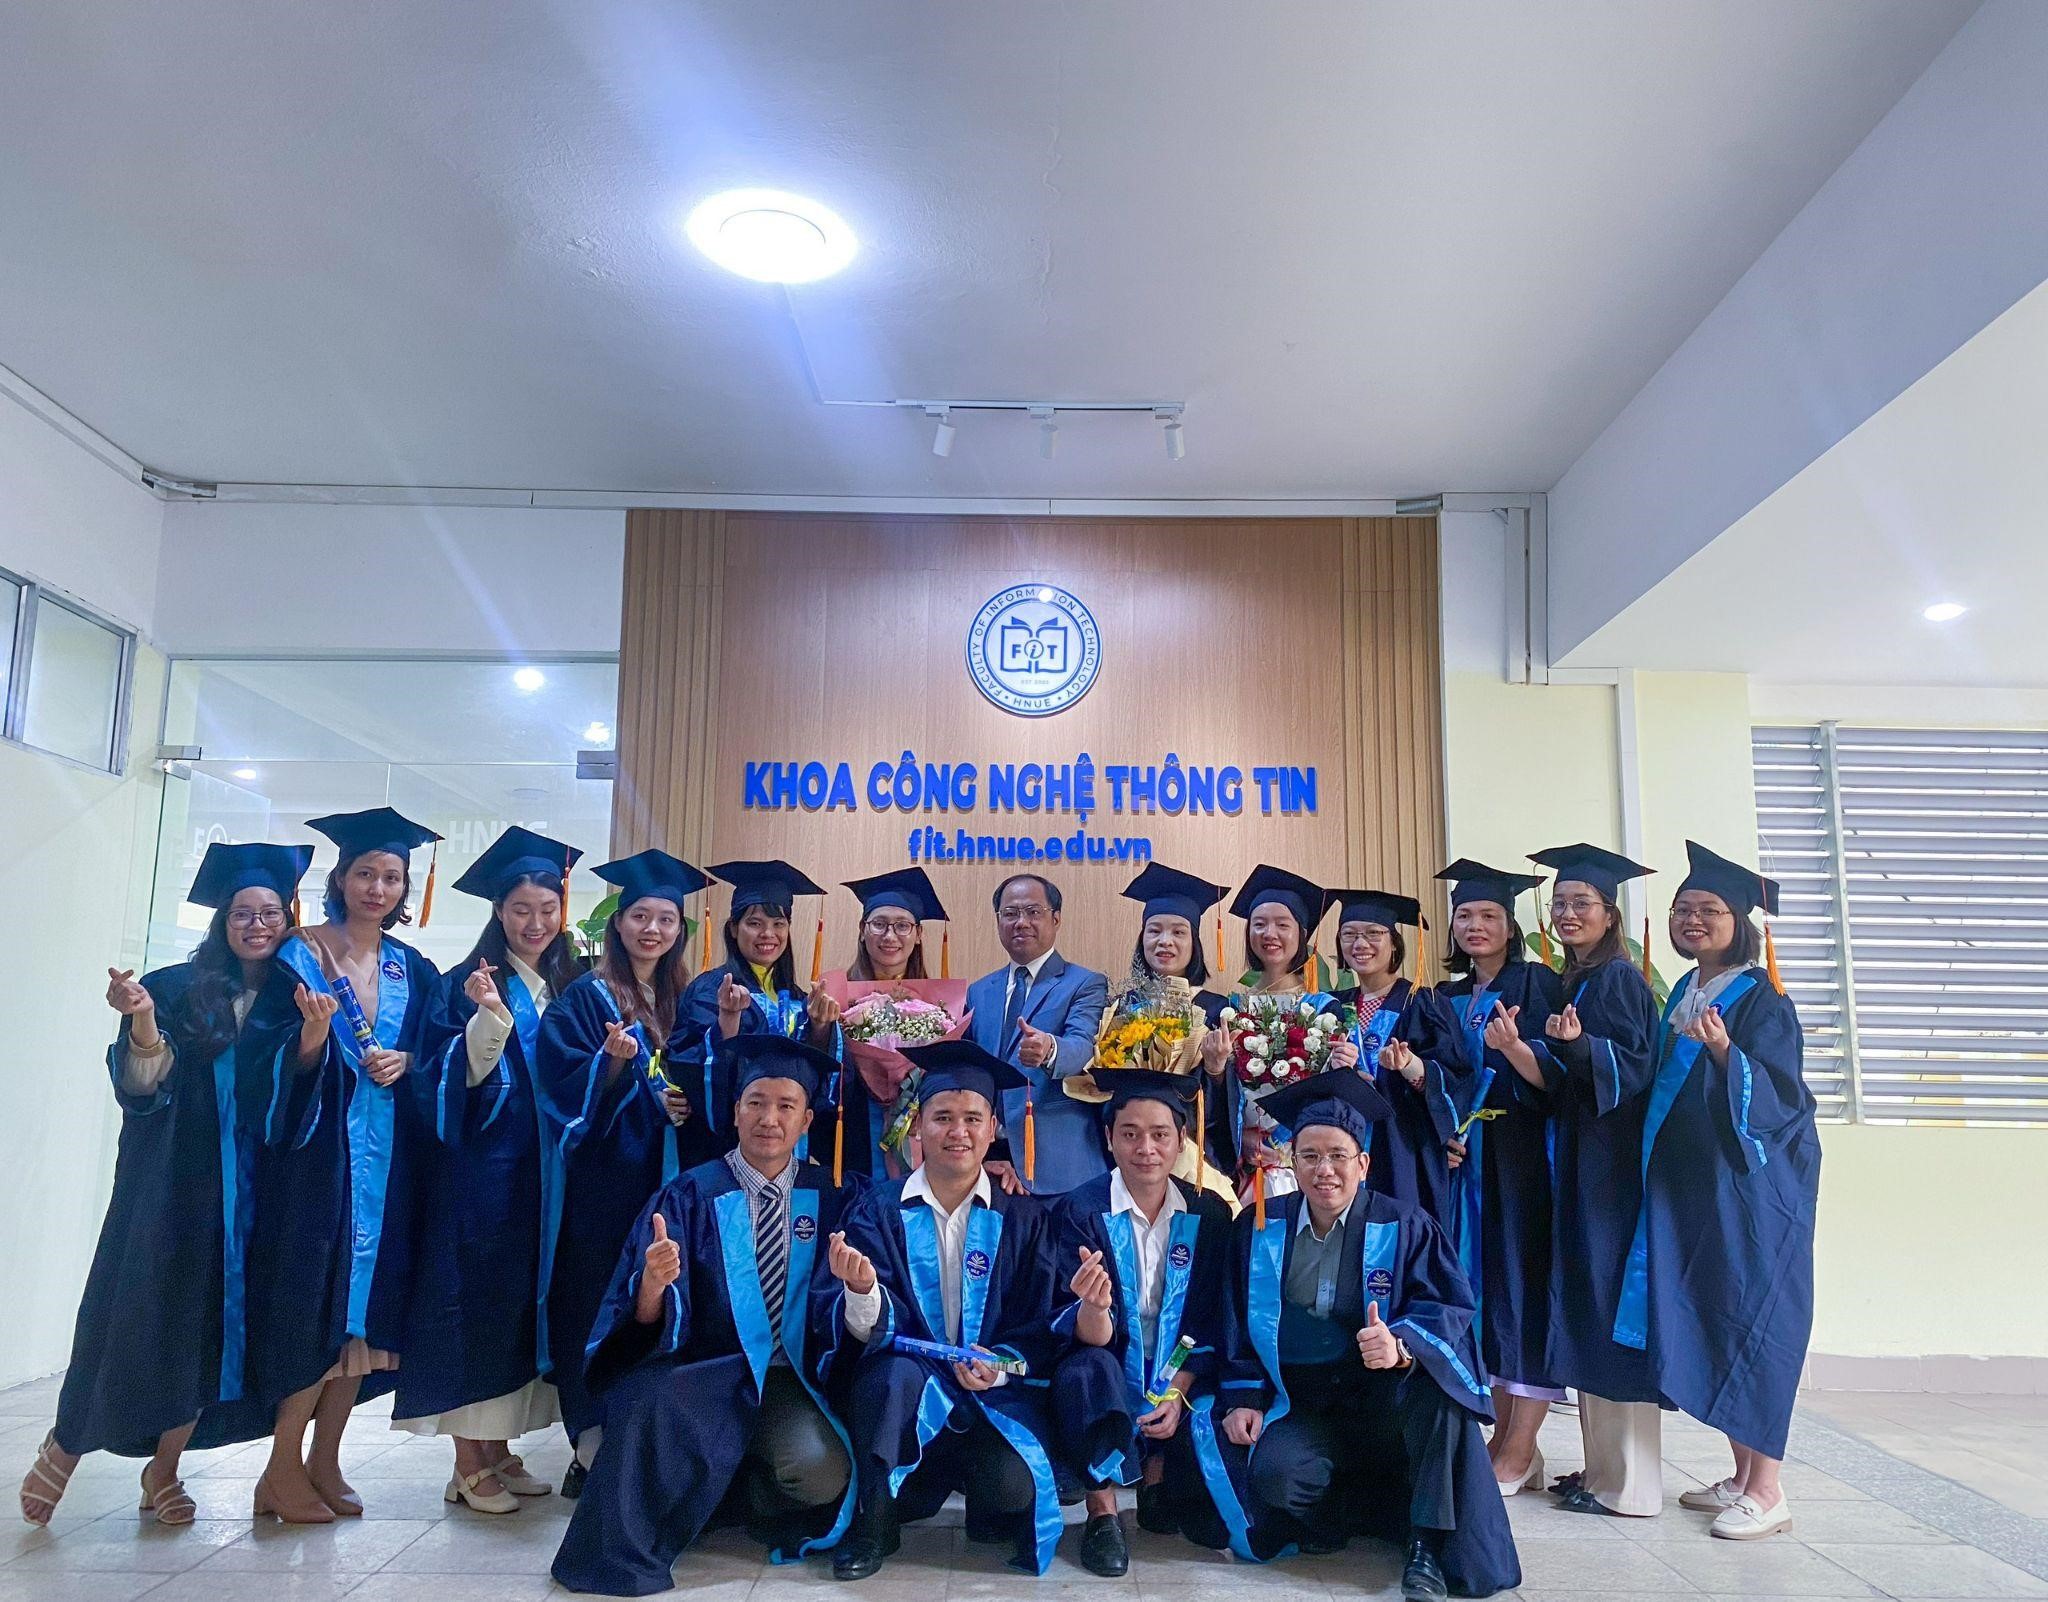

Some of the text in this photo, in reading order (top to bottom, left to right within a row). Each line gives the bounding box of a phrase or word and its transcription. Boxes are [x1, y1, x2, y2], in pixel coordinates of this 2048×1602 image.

[972, 588, 1096, 699] FACULTY OF INFORMION TECHNOLOGY
[1013, 698, 1052, 709] HNUE
[744, 750, 1318, 823] KHOA CÔNG NGHỆ THÔNG TIN
[447, 820, 548, 854] HN
[907, 825, 1153, 864] fit.hnue.edu.vn
